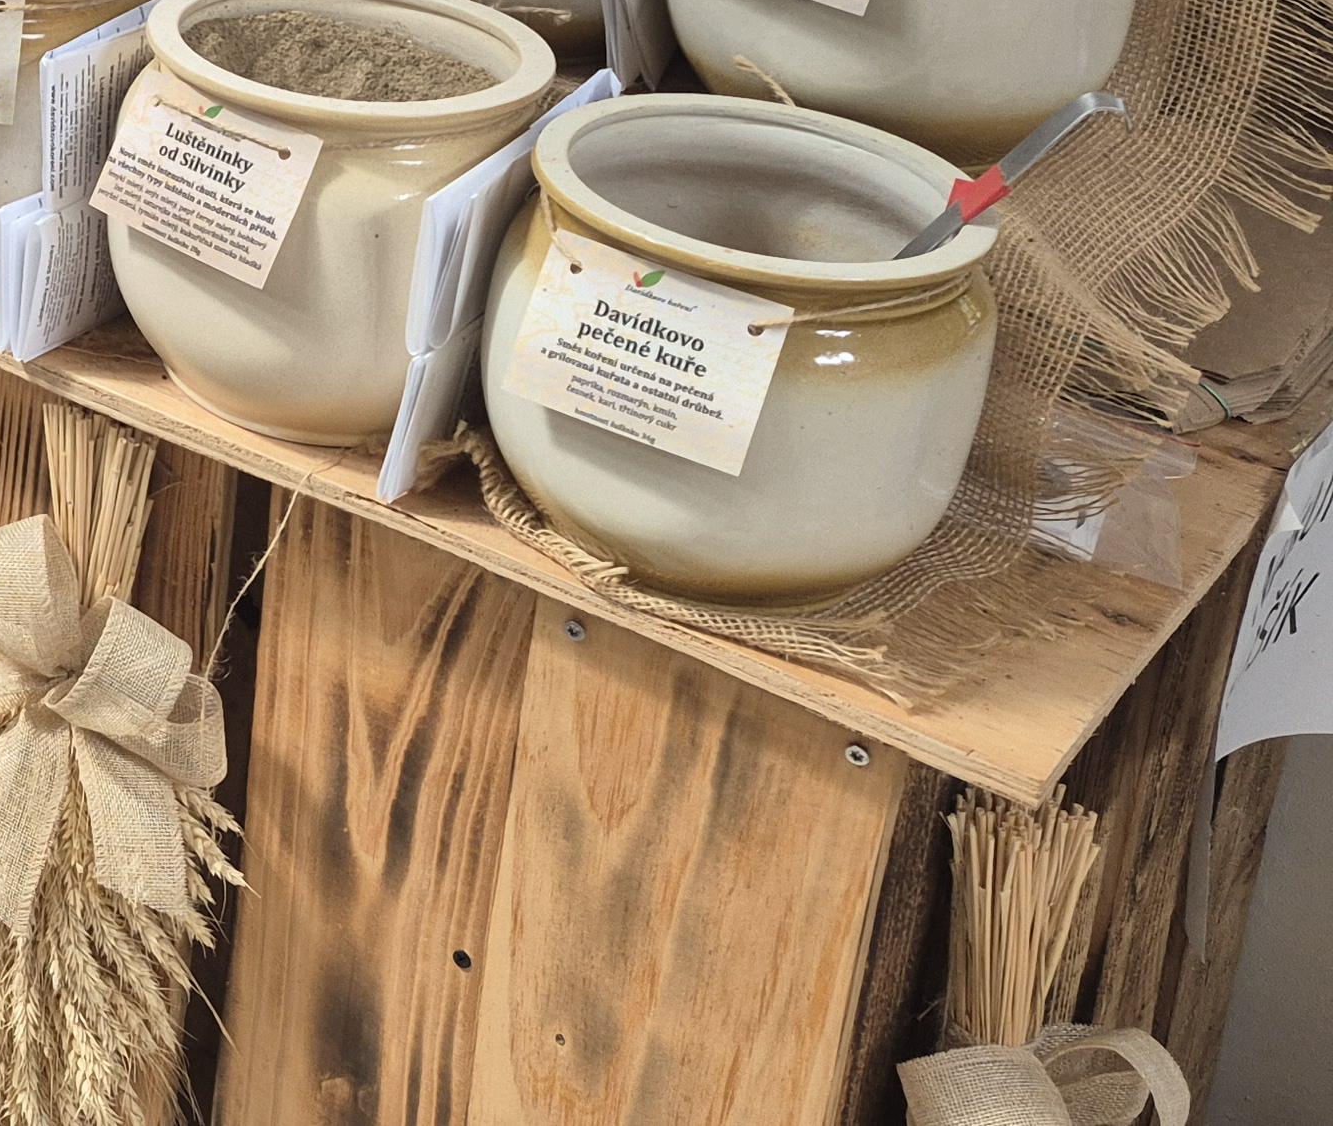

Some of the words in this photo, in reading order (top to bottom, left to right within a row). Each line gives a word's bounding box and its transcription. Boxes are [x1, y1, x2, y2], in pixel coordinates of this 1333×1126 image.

[158, 143, 179, 162] od
[179, 151, 247, 194] Silvinky
[164, 122, 255, 175] Luštěninky
[576, 320, 652, 359] pečené
[654, 345, 709, 379] kuře
[593, 299, 706, 353] Davídkovo
[547, 349, 595, 373] grilovaná
[596, 365, 632, 388] kuřata
[641, 382, 681, 405] ostatní
[681, 398, 724, 421] drůbež.
[556, 336, 583, 356] Směs
[583, 346, 619, 369] koření
[619, 358, 657, 381] určená
[658, 375, 673, 387] na
[673, 379, 716, 403] pečená
